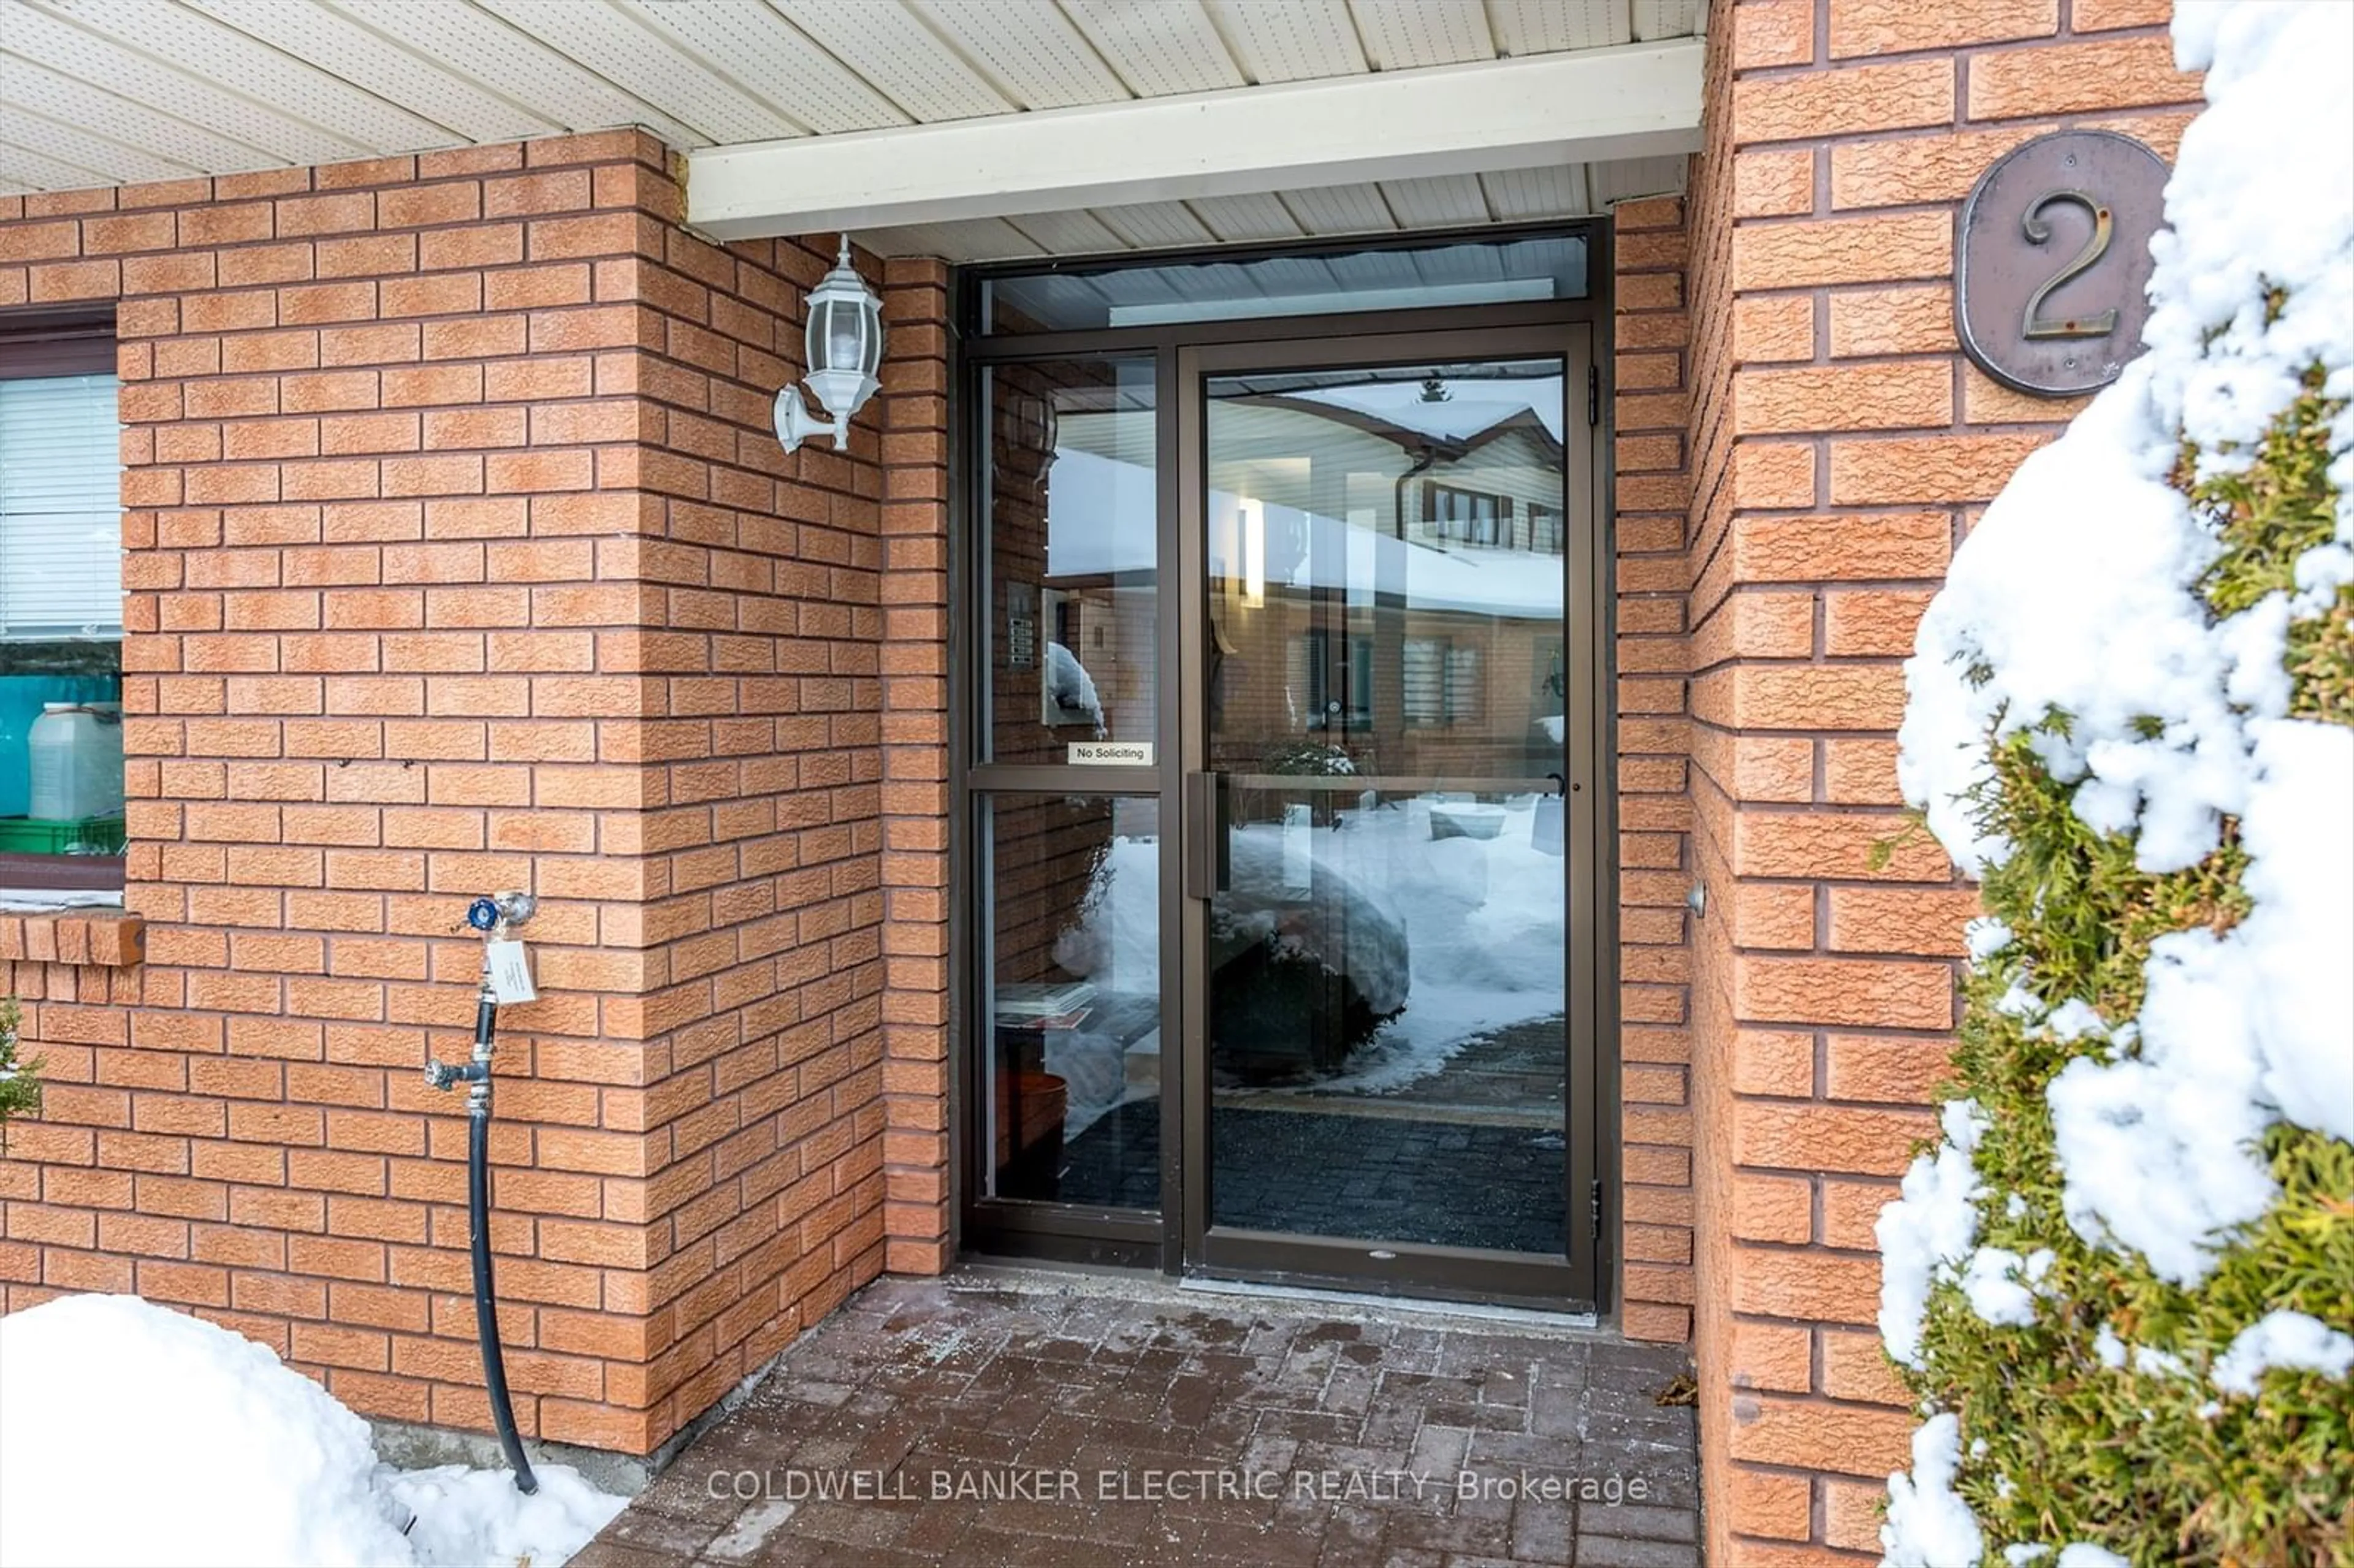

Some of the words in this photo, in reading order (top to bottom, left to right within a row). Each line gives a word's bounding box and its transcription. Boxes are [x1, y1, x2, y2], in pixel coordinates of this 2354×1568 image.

[2023, 189, 2119, 340] 2
[1077, 748, 1092, 758] No
[1095, 747, 1144, 760] Soliciting
